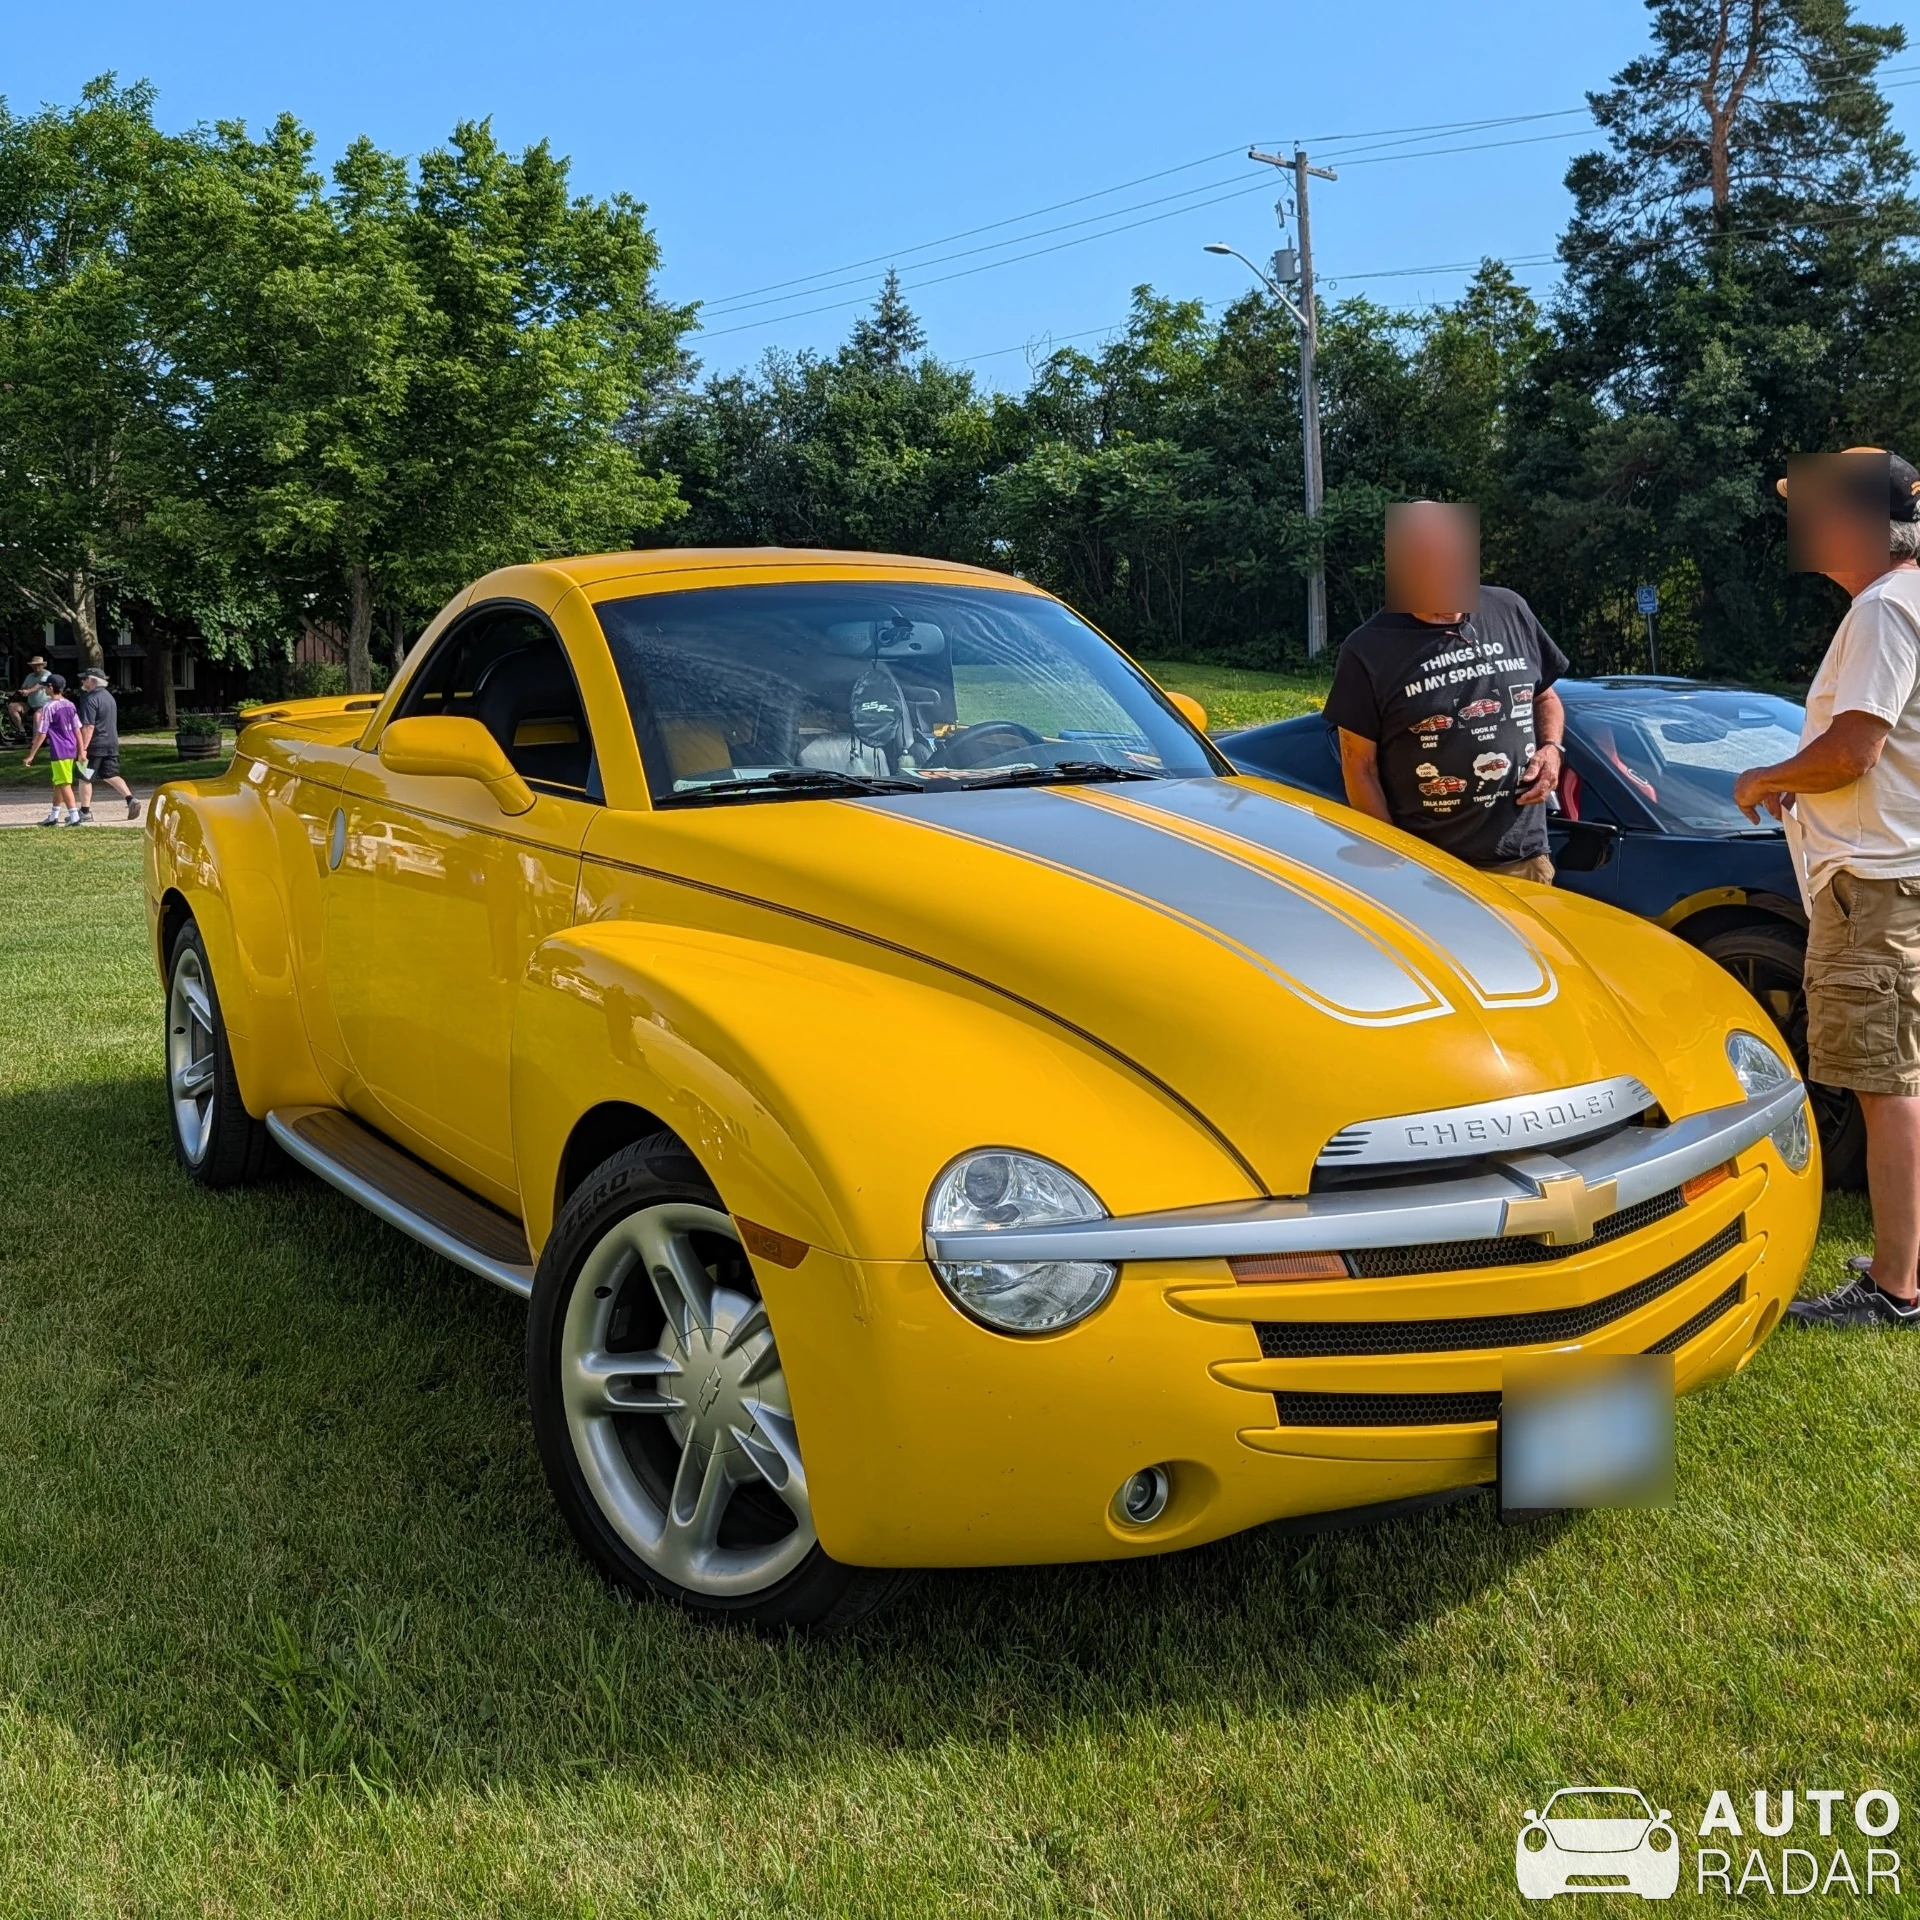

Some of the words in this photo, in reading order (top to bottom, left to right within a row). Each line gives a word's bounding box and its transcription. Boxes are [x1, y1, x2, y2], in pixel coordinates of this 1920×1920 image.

[1420, 647, 1475, 672] THINGS
[1483, 642, 1504, 656] DO
[1404, 681, 1423, 698] IN
[1424, 673, 1447, 692] MY
[1448, 662, 1496, 684] SPARE
[1494, 657, 1528, 673] TIME
[861, 700, 895, 713] SSR
[1471, 725, 1489, 736] LOOK
[1489, 724, 1498, 732] AT
[1420, 734, 1439, 742] DRIVE
[1477, 733, 1495, 742] CARS
[1422, 741, 1437, 749] CARS
[1438, 798, 1461, 806] ABOUT
[1472, 794, 1492, 803] THINK
[1404, 1090, 1617, 1148] CHEVROLET
[563, 1169, 629, 1240] ZERO
